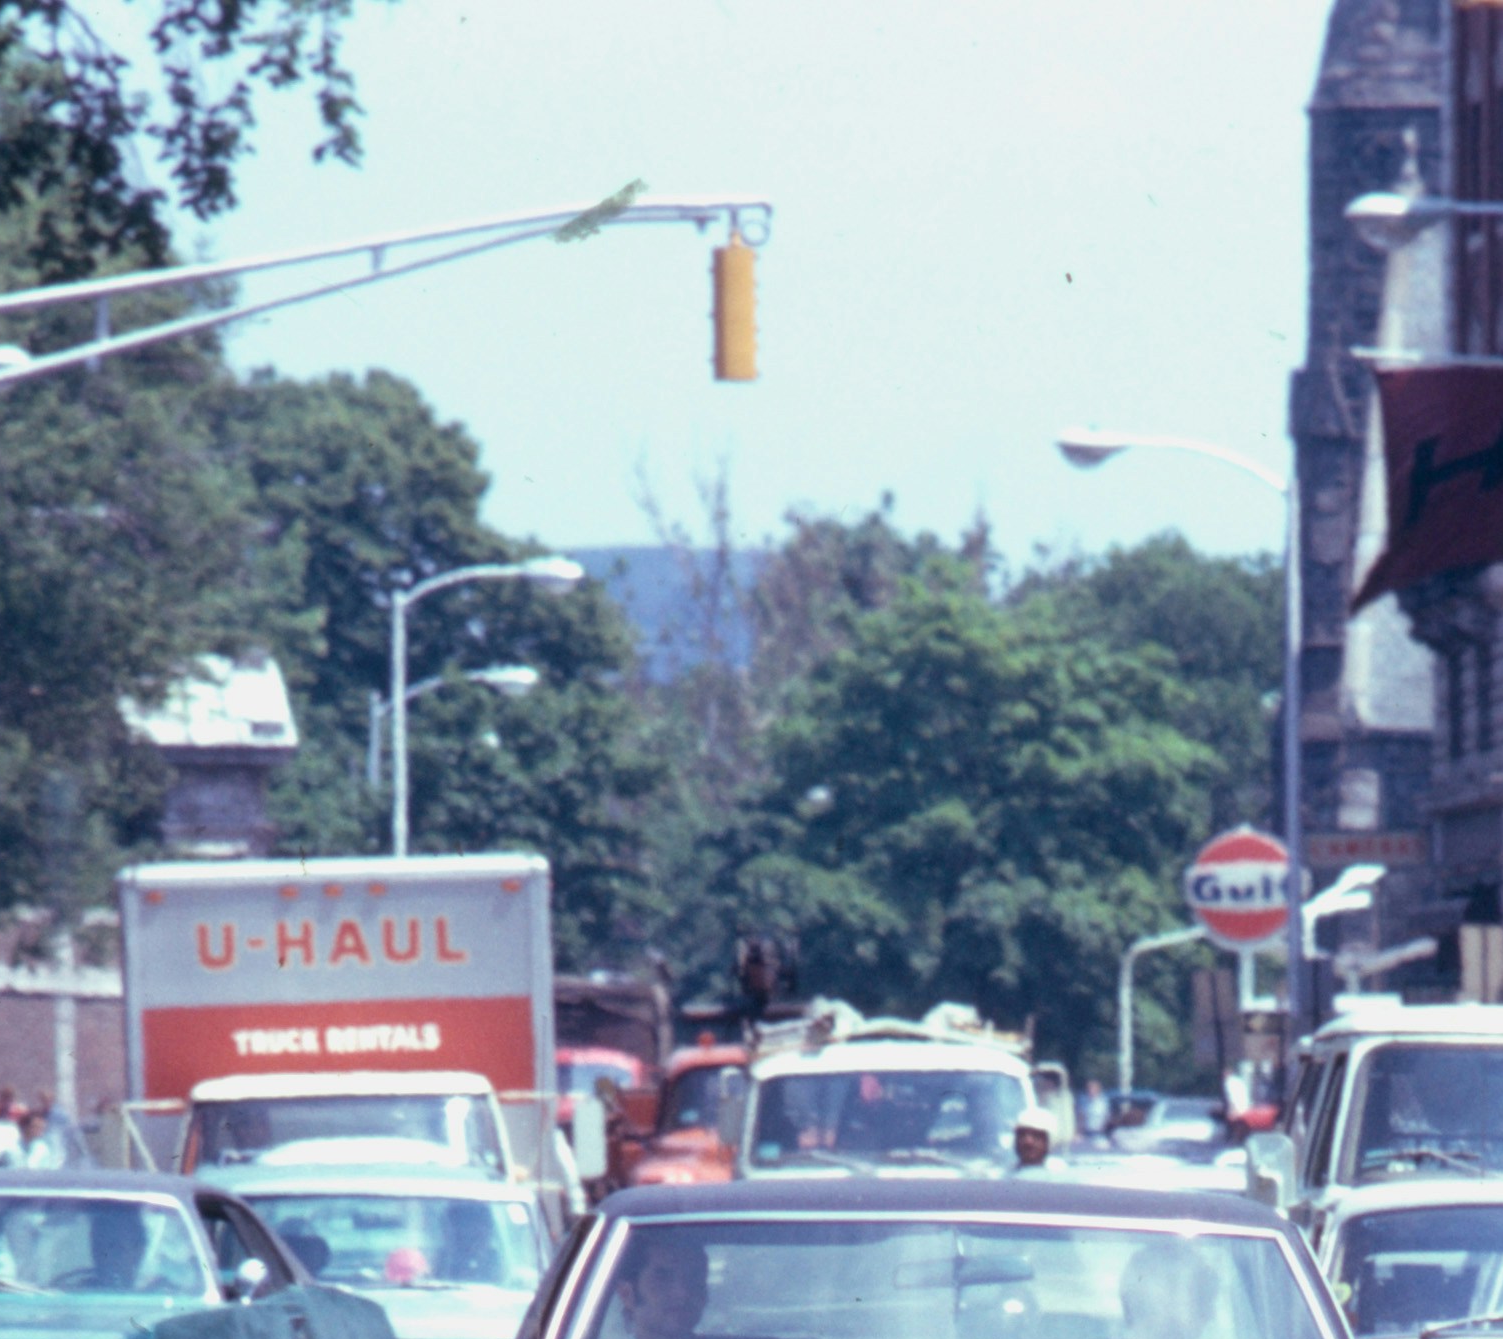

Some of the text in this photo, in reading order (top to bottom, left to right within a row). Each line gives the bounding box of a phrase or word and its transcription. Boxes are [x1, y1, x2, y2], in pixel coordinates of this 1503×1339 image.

[195, 915, 469, 970] U-HAUL
[231, 1022, 440, 1056] TRUCK RENTALS
